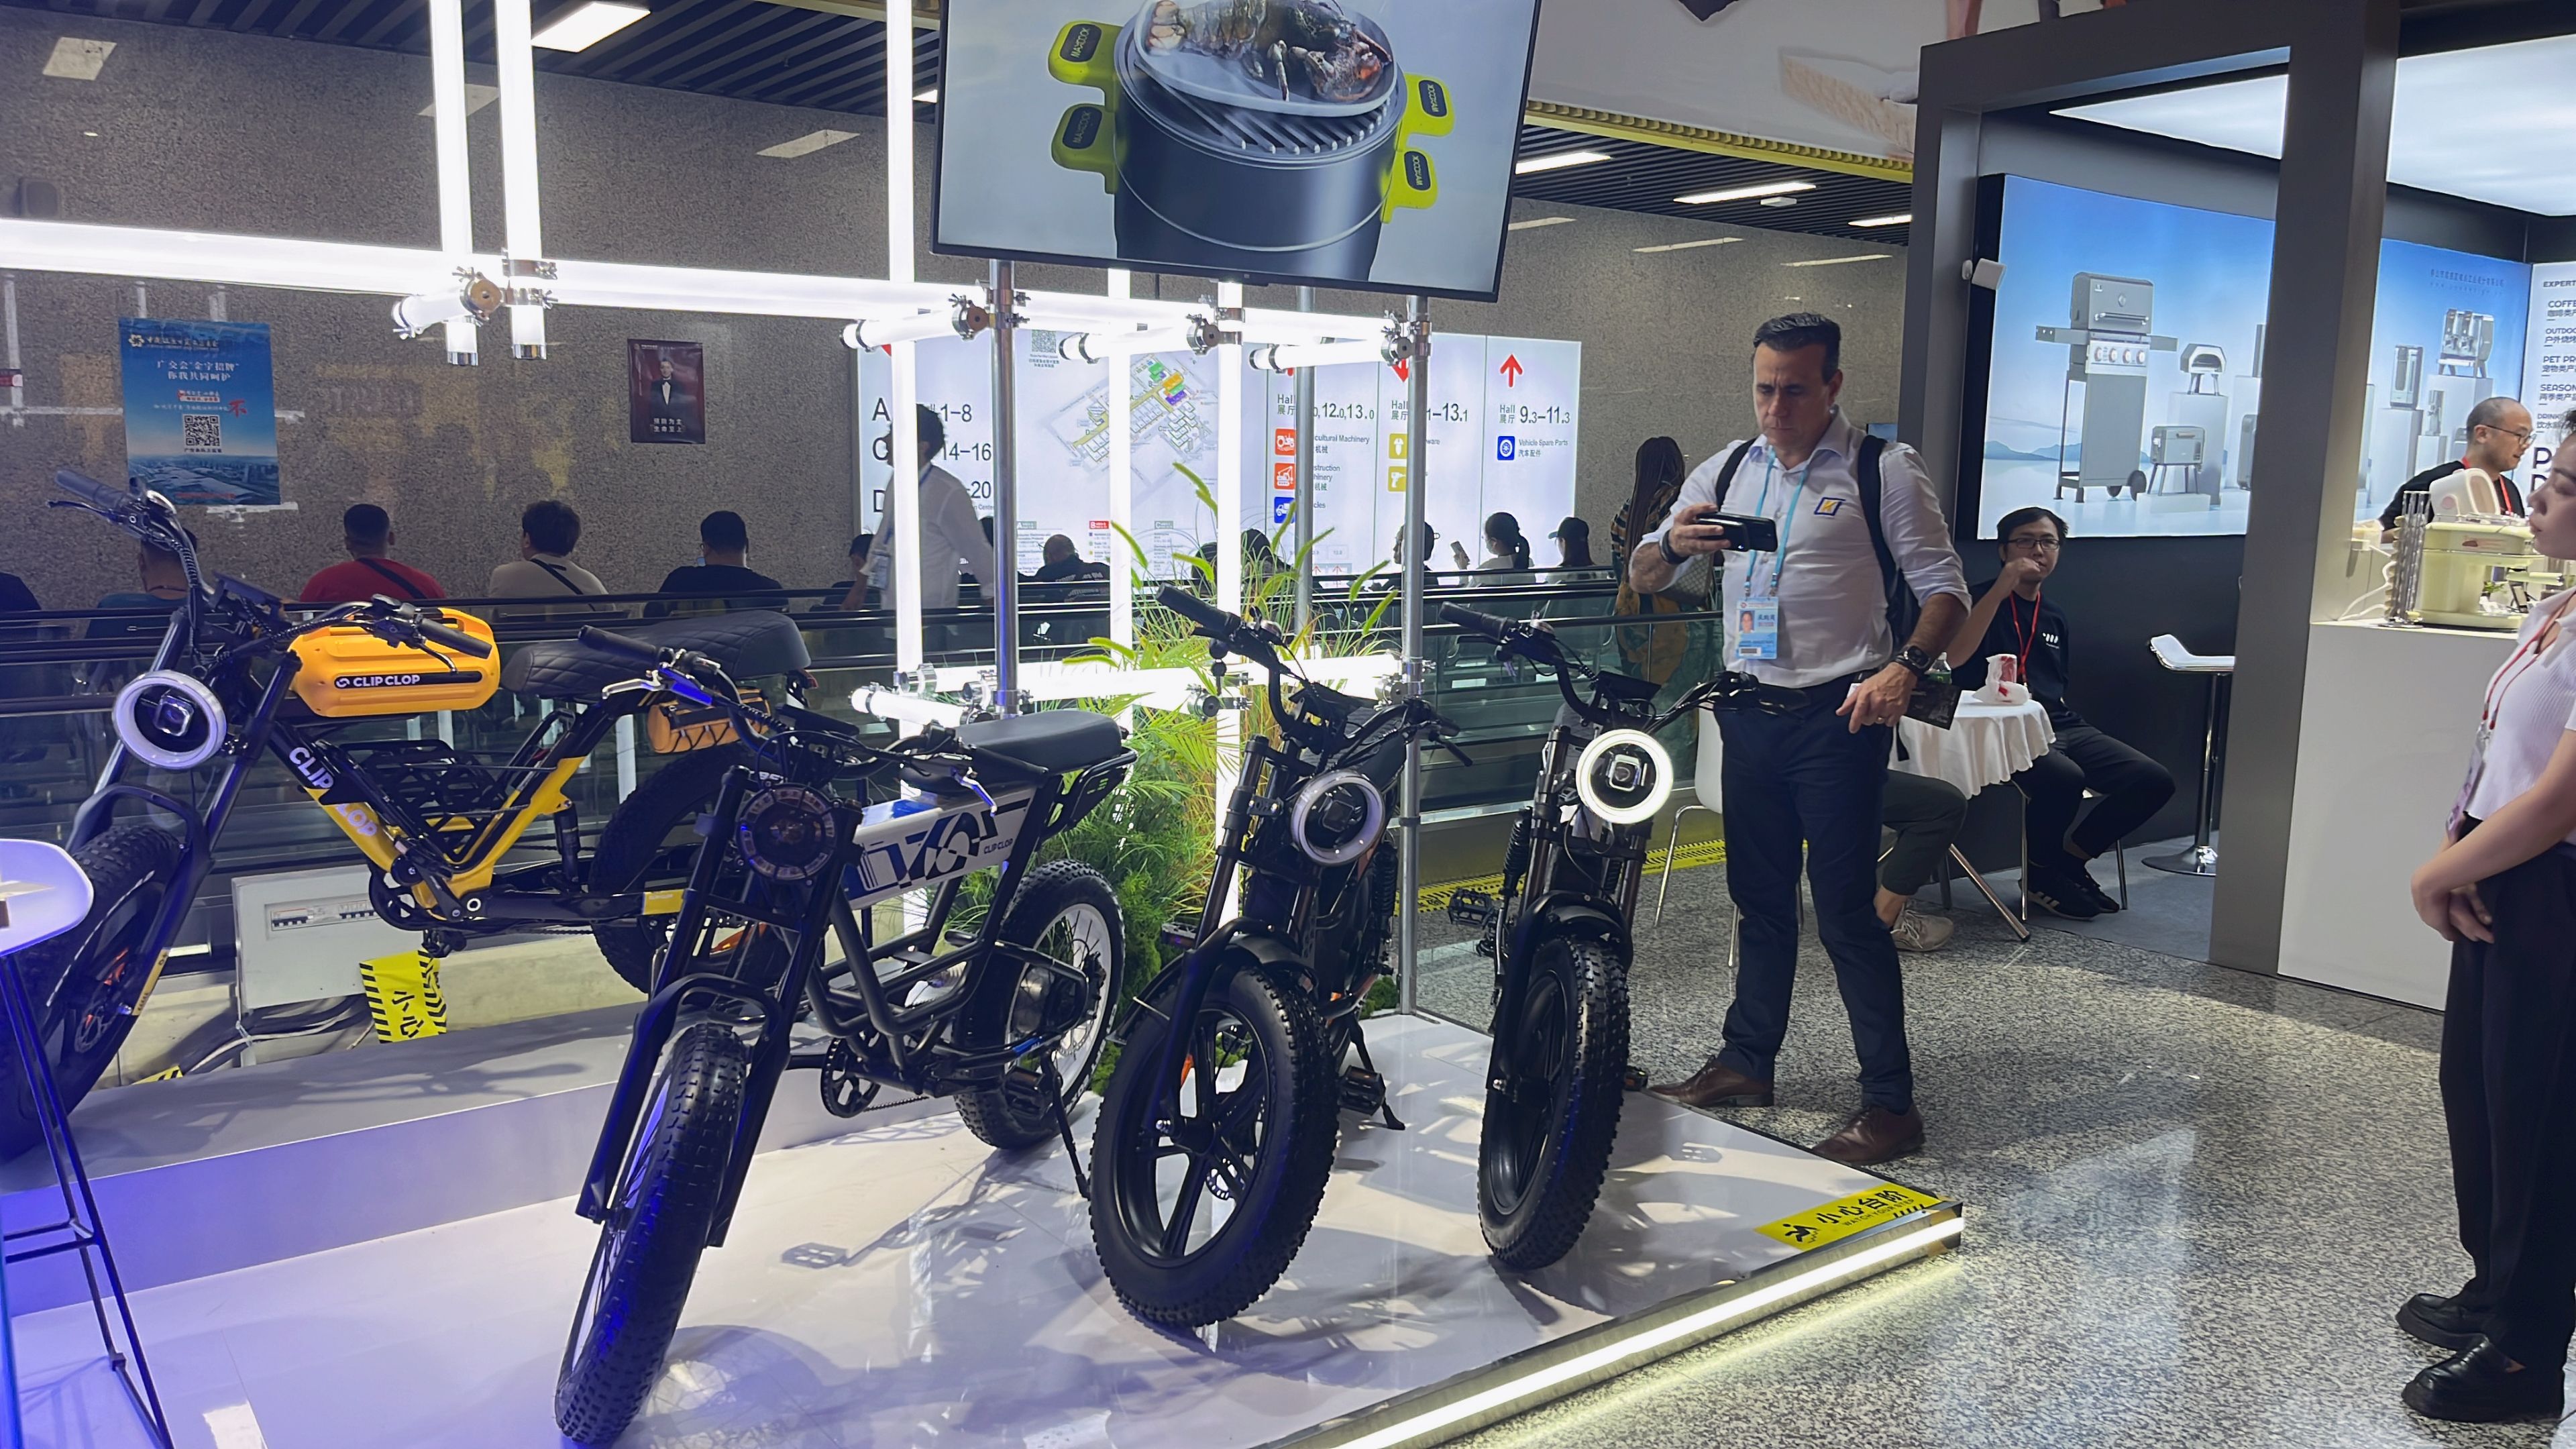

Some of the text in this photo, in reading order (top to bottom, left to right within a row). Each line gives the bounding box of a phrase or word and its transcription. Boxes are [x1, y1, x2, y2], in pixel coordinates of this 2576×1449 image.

[872, 398, 890, 421] A
[1277, 405, 1295, 415] 展厅
[1499, 405, 1515, 413] Hall
[1391, 410, 1408, 420] 展厅
[1499, 414, 1515, 424] 展厅
[1339, 435, 1370, 444] Machinery
[1315, 445, 1328, 453] 机械
[1314, 483, 1327, 491] 机械
[353, 674, 421, 687] CLIP CLOP
[289, 747, 378, 837] CLIP LOP
[984, 838, 1013, 854] CLIP CLOP
[1817, 1189, 1909, 1224] 小心台阶
[1842, 1199, 1915, 1226] WATCH YOUR STEP
